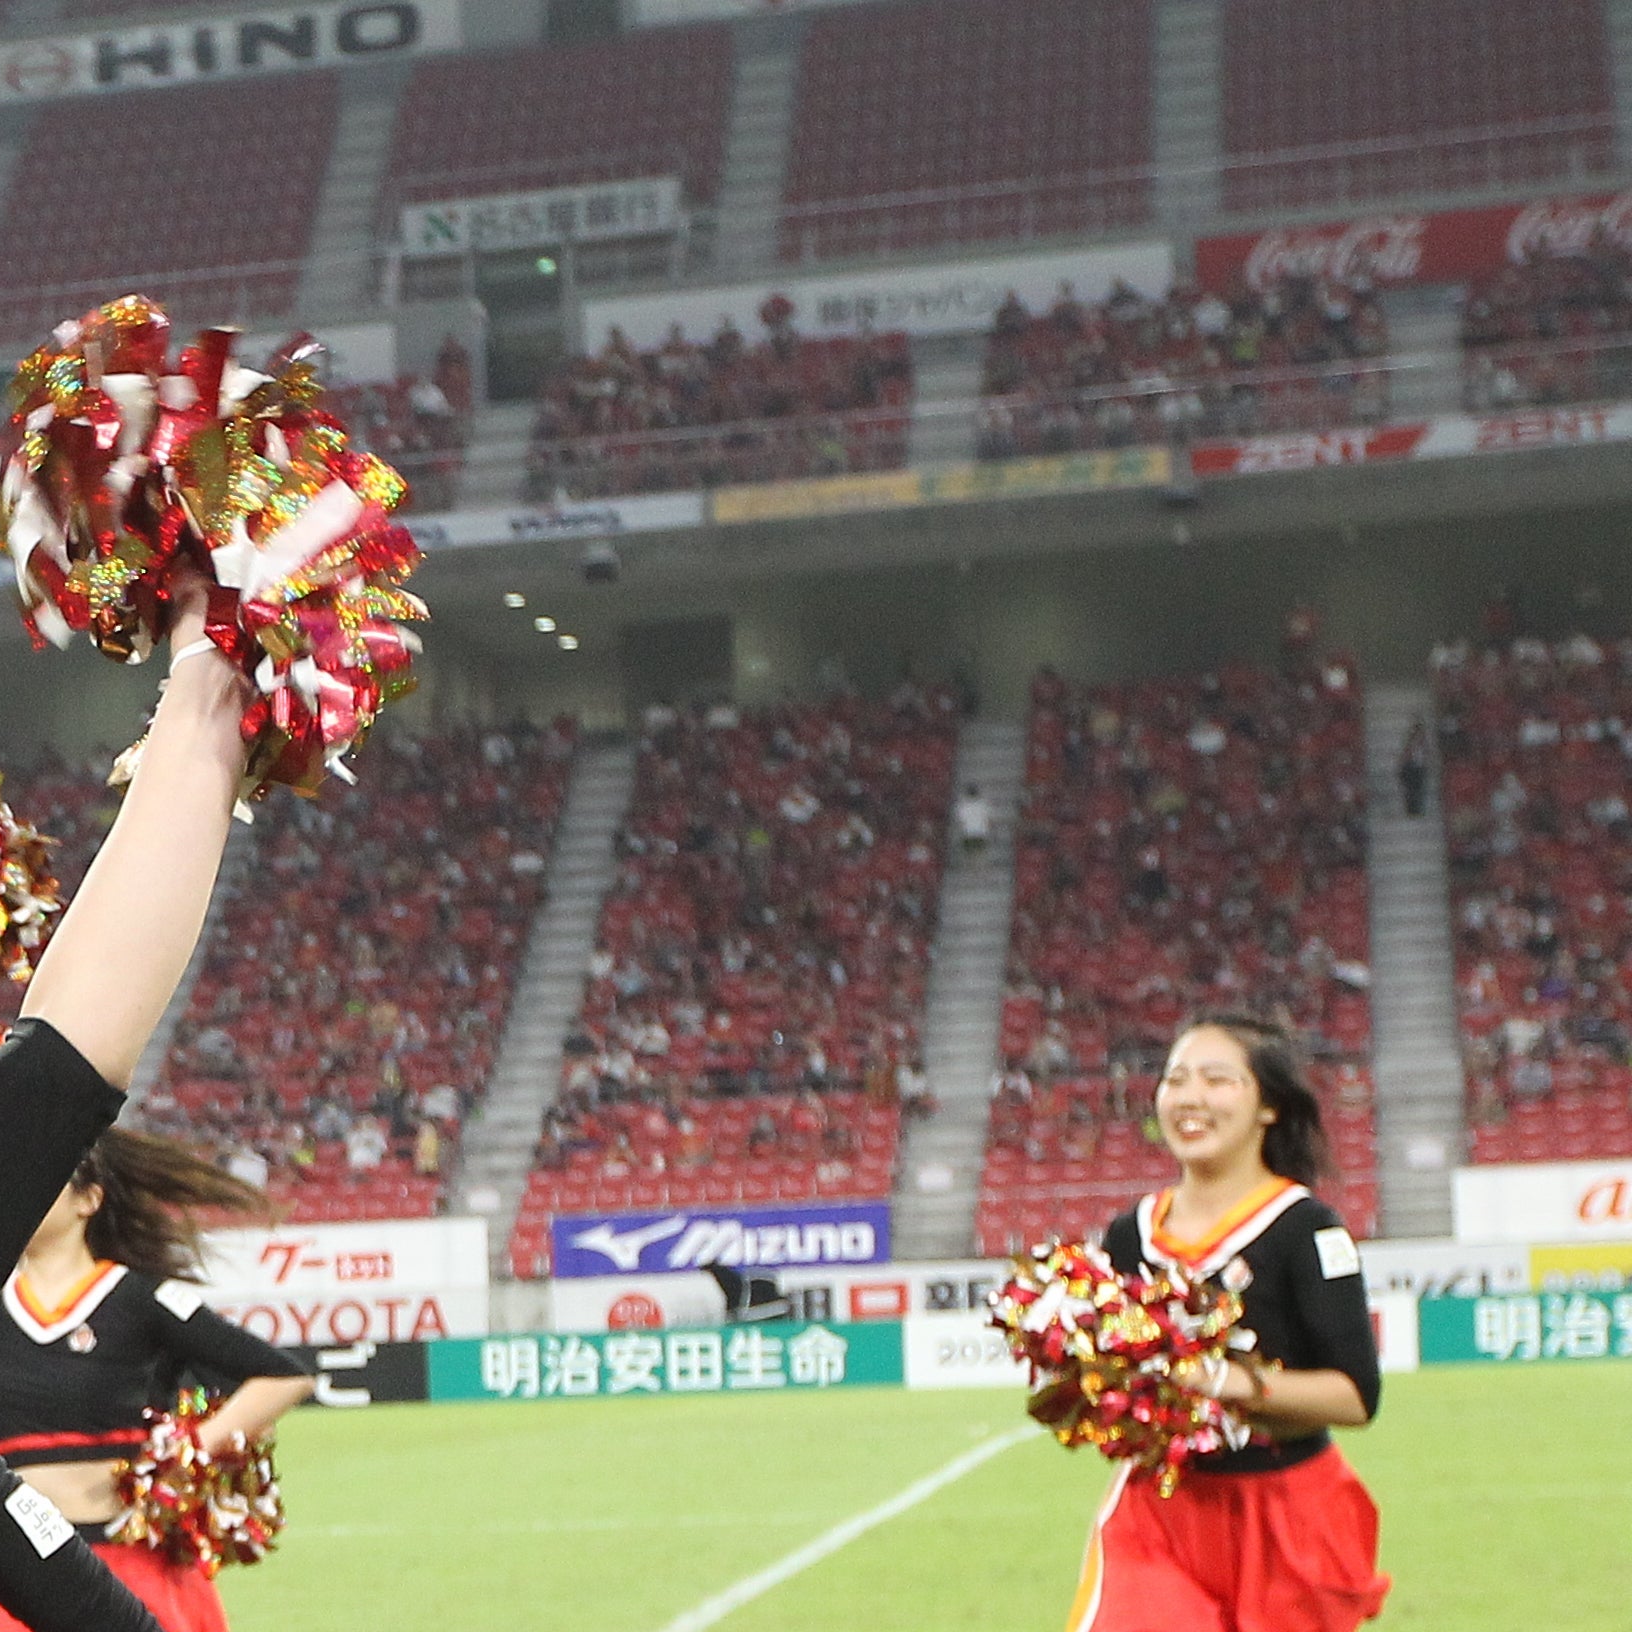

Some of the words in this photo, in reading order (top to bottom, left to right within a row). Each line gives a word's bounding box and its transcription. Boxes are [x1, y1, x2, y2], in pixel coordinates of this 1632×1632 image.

[96, 3, 420, 84] HINO
[480, 1325, 848, 1400] 明治安田生命
